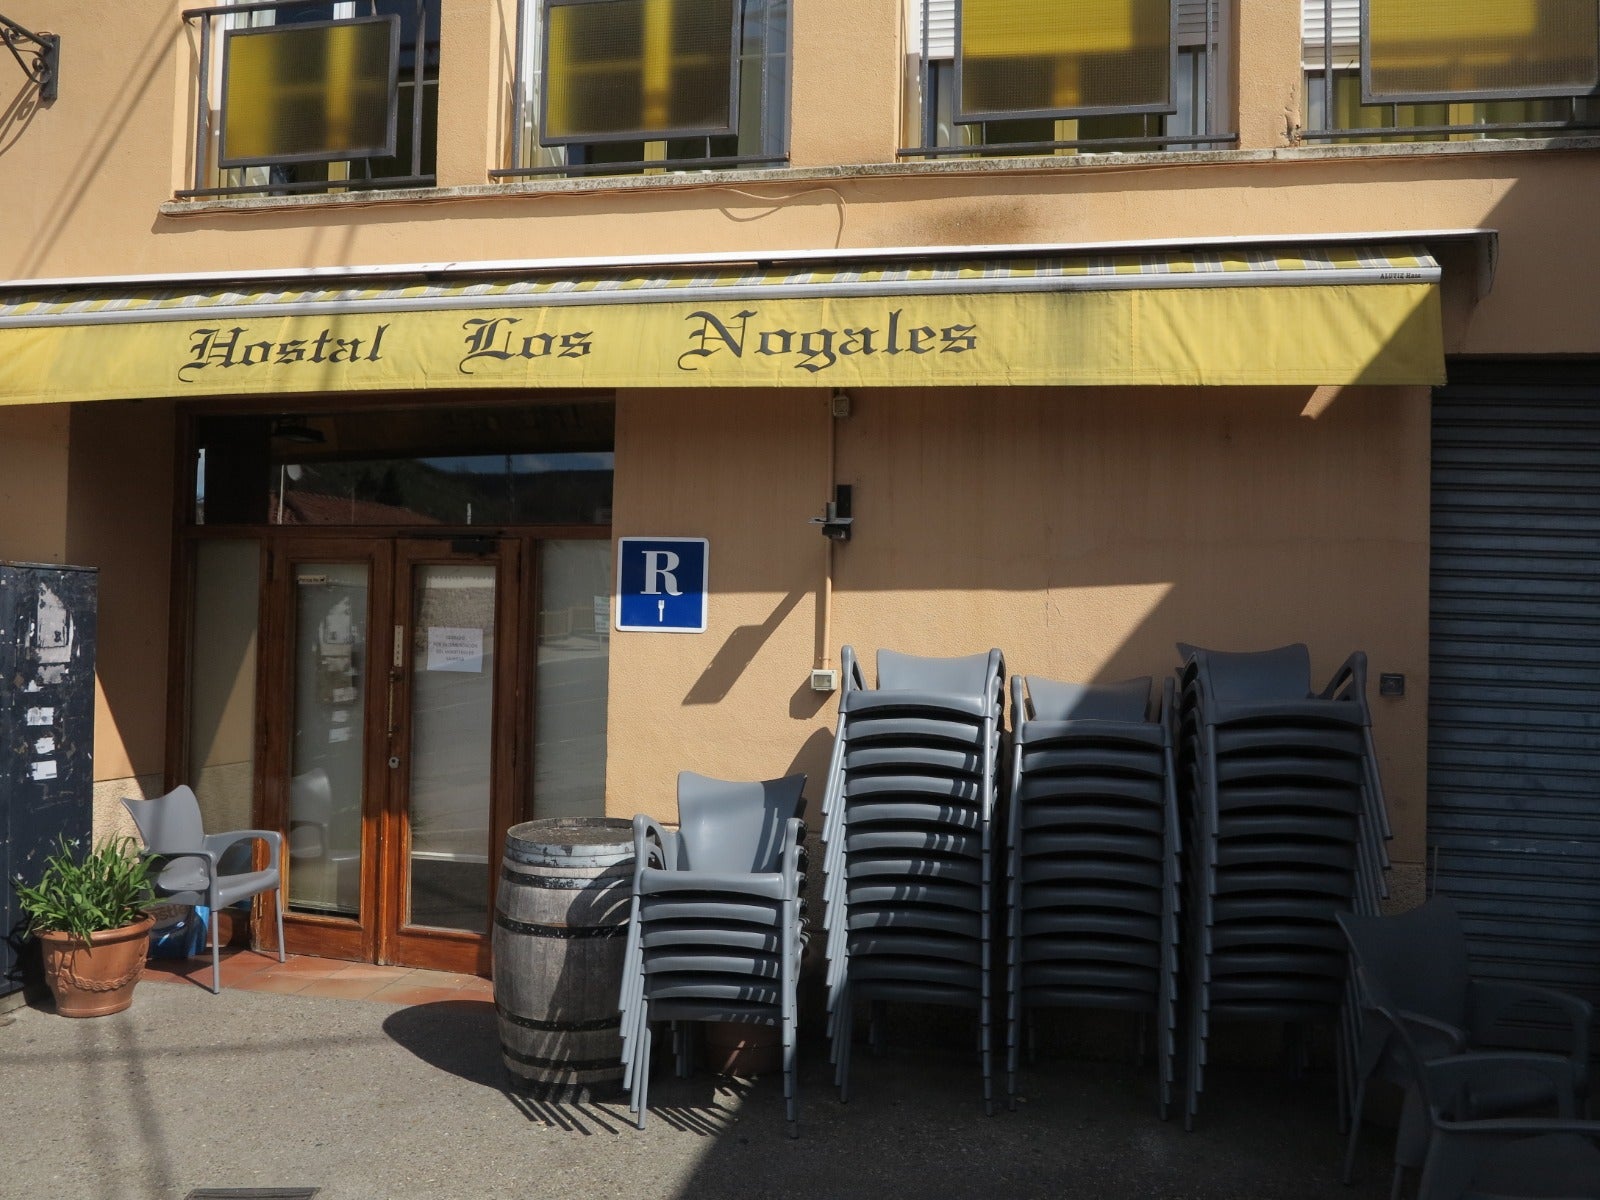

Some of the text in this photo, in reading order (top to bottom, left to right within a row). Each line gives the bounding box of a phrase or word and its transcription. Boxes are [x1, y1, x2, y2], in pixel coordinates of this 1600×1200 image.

[178, 309, 977, 383] Hostal Los Nogales
[640, 550, 683, 596] R
